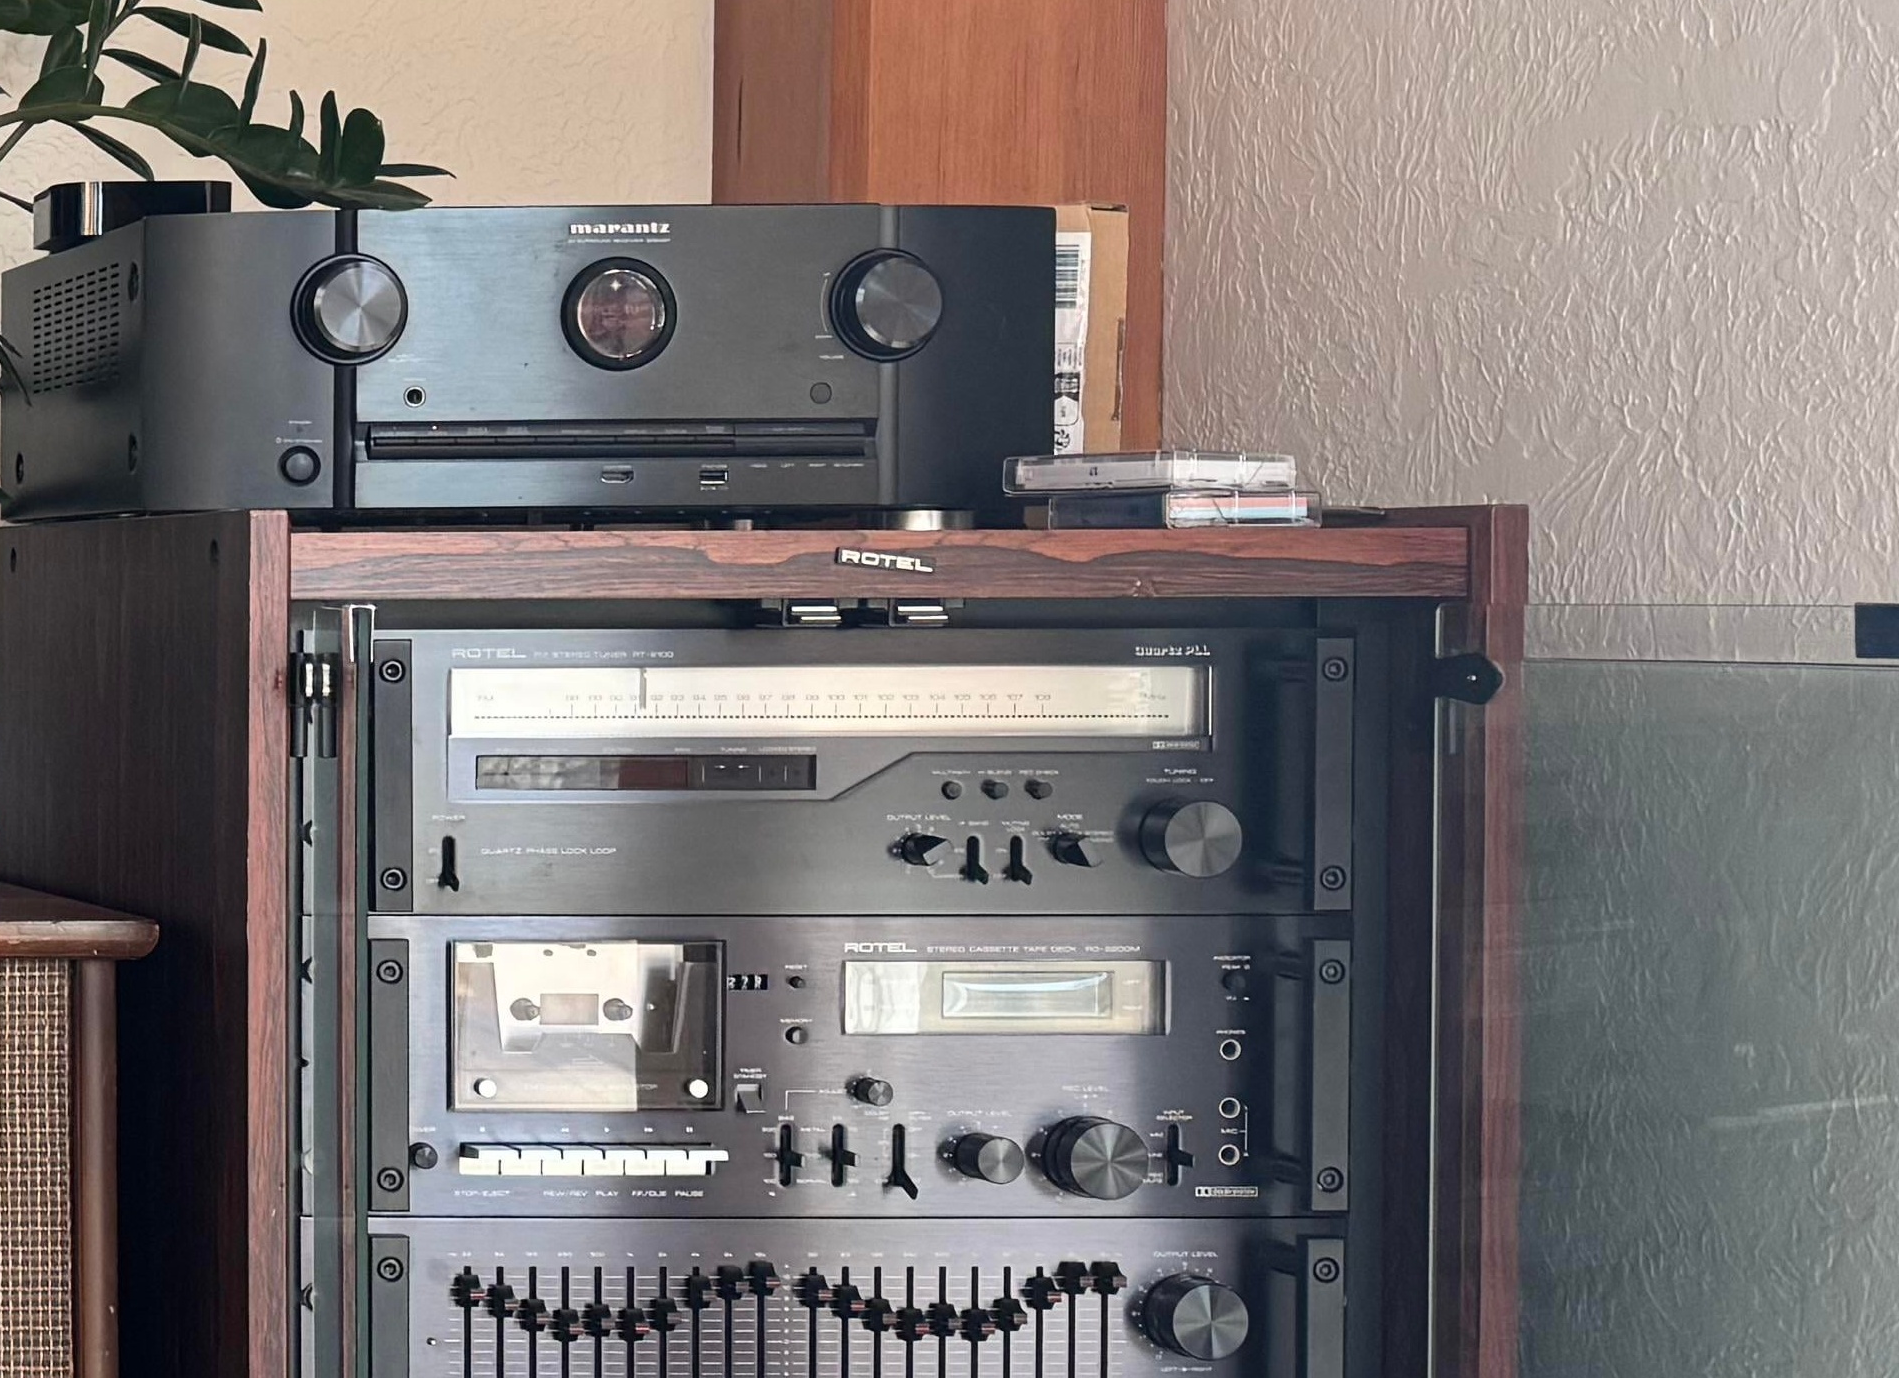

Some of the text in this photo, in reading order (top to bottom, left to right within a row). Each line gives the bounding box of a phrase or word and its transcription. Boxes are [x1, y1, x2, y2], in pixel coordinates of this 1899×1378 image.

[570, 222, 670, 234] marantz
[841, 549, 934, 572] ROTEL
[452, 648, 527, 658] ROTEL
[844, 942, 917, 953] ROTEL
